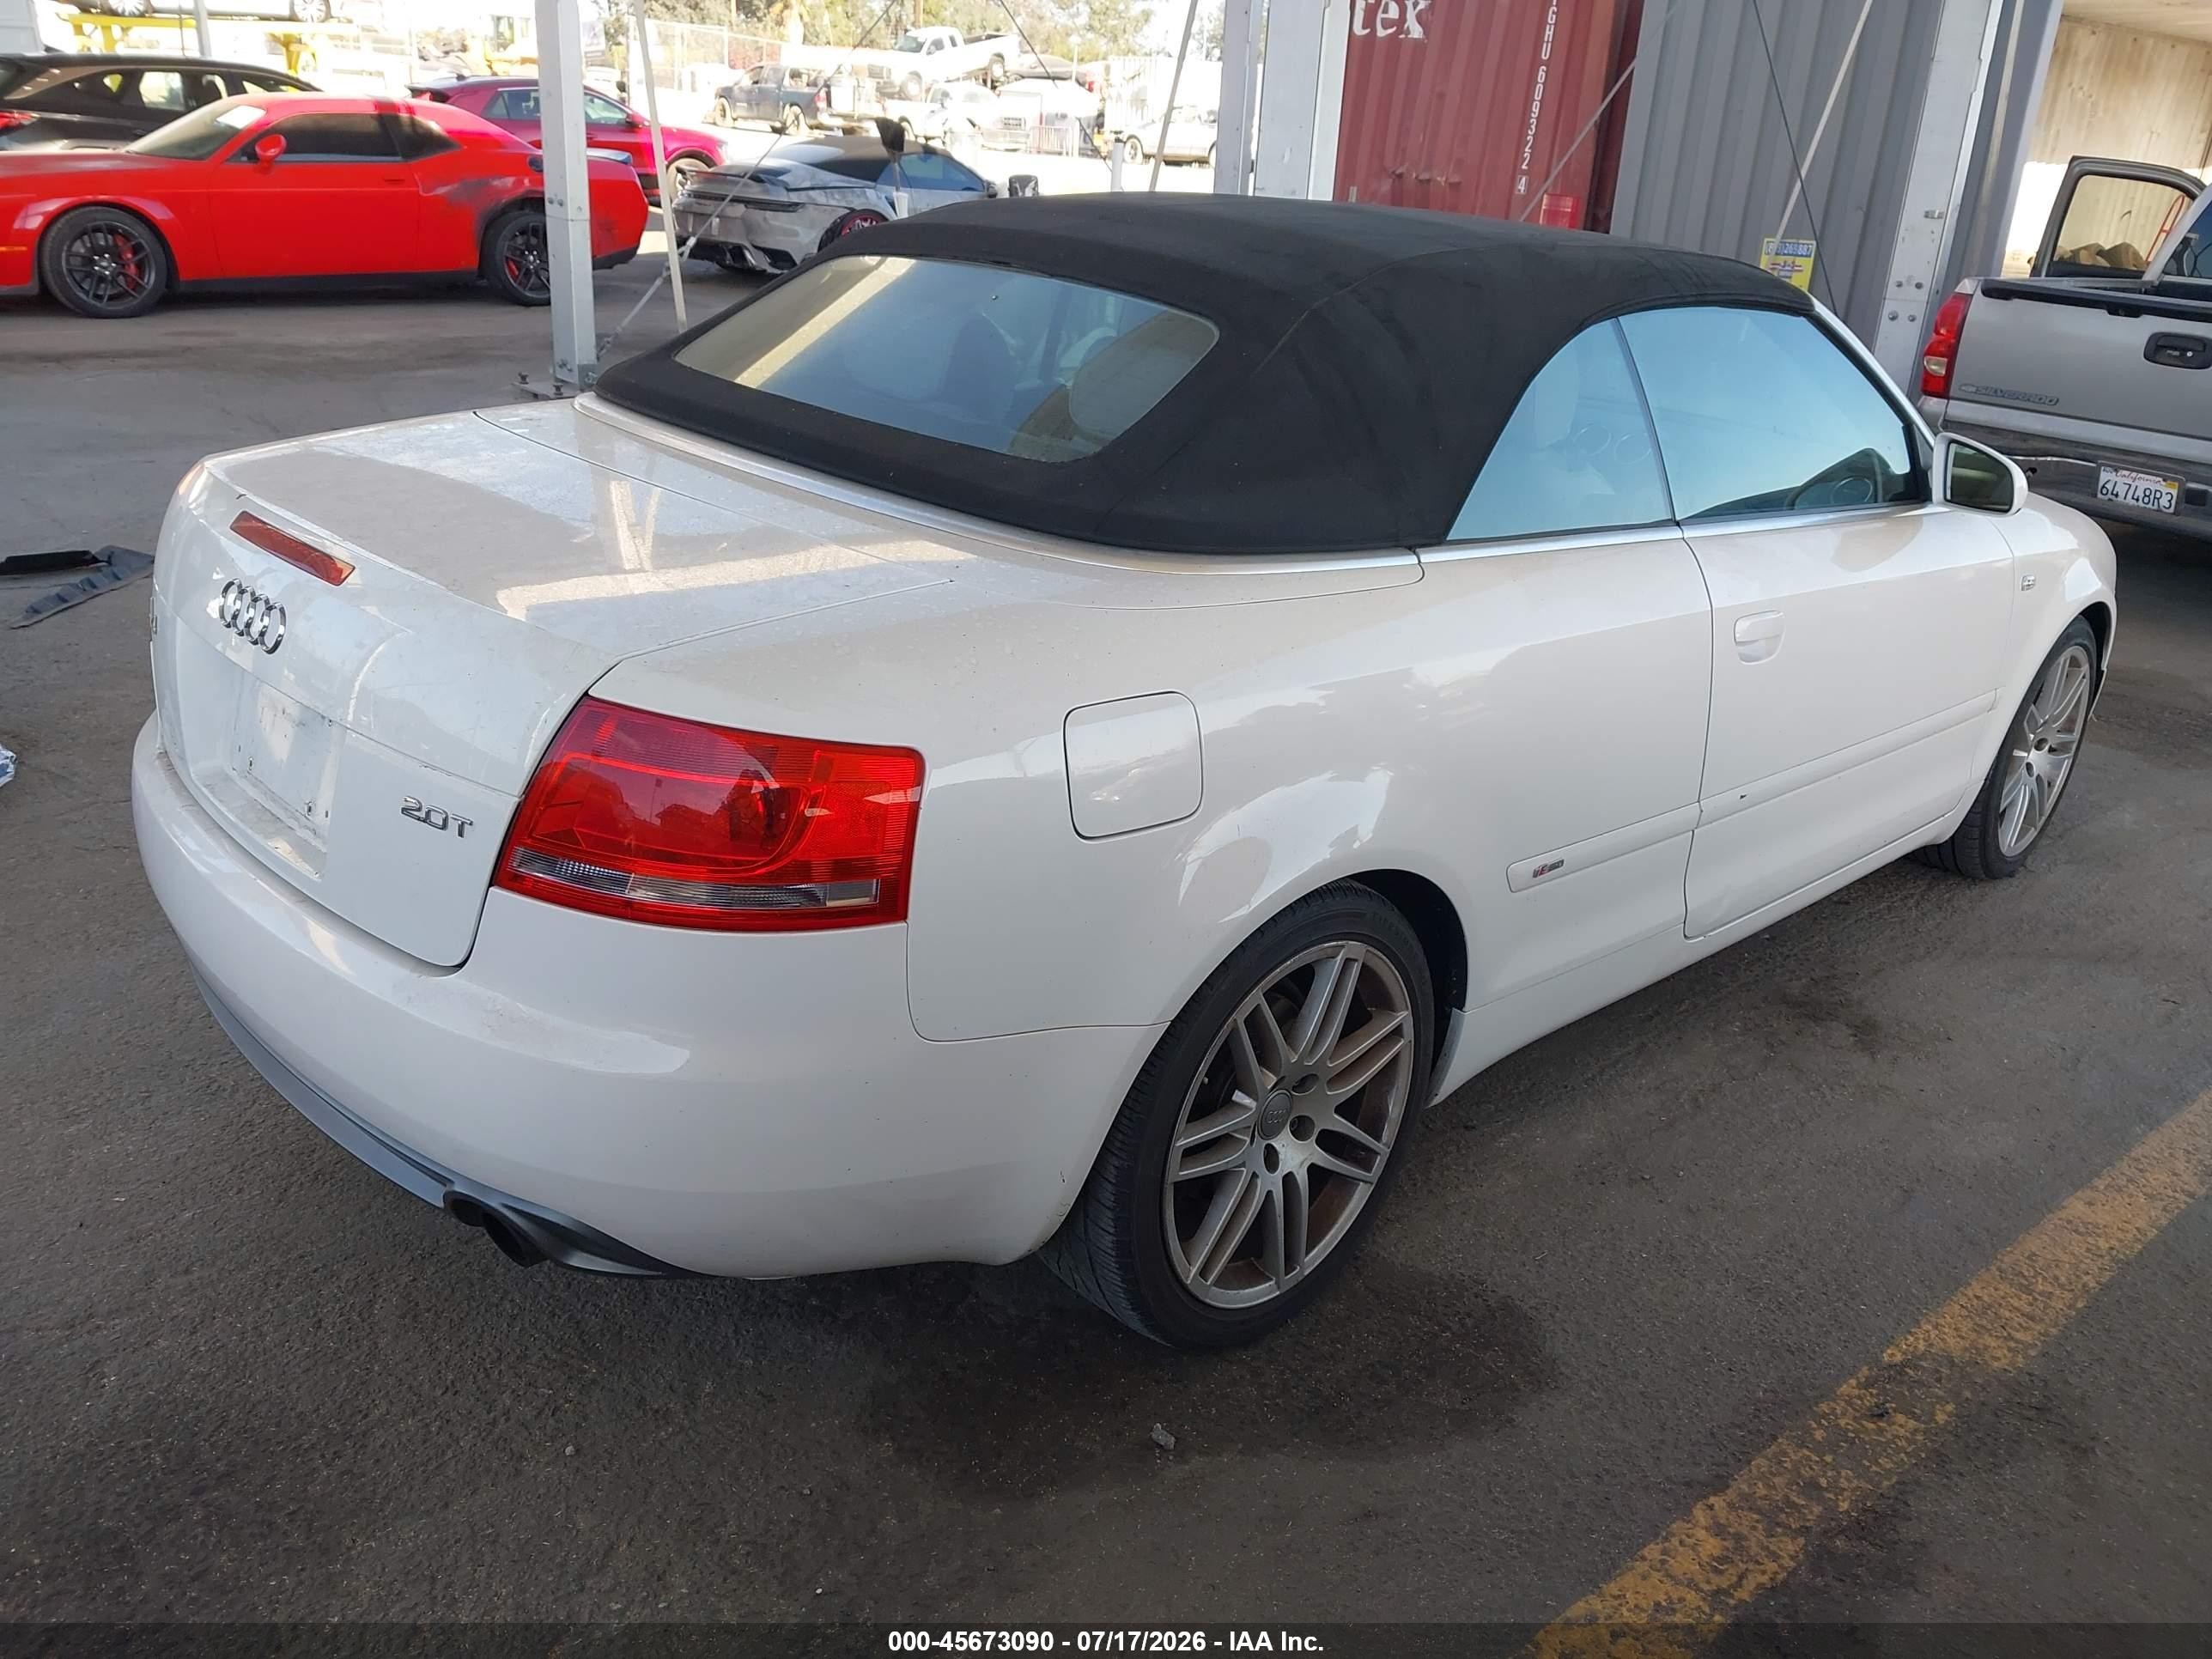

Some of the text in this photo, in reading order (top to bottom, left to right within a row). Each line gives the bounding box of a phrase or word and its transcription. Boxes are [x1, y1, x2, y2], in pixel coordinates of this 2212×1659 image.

[1352, 0, 1431, 39] tex
[1521, 65, 1547, 170] 609322
[2100, 479, 2174, 510] 64748R3
